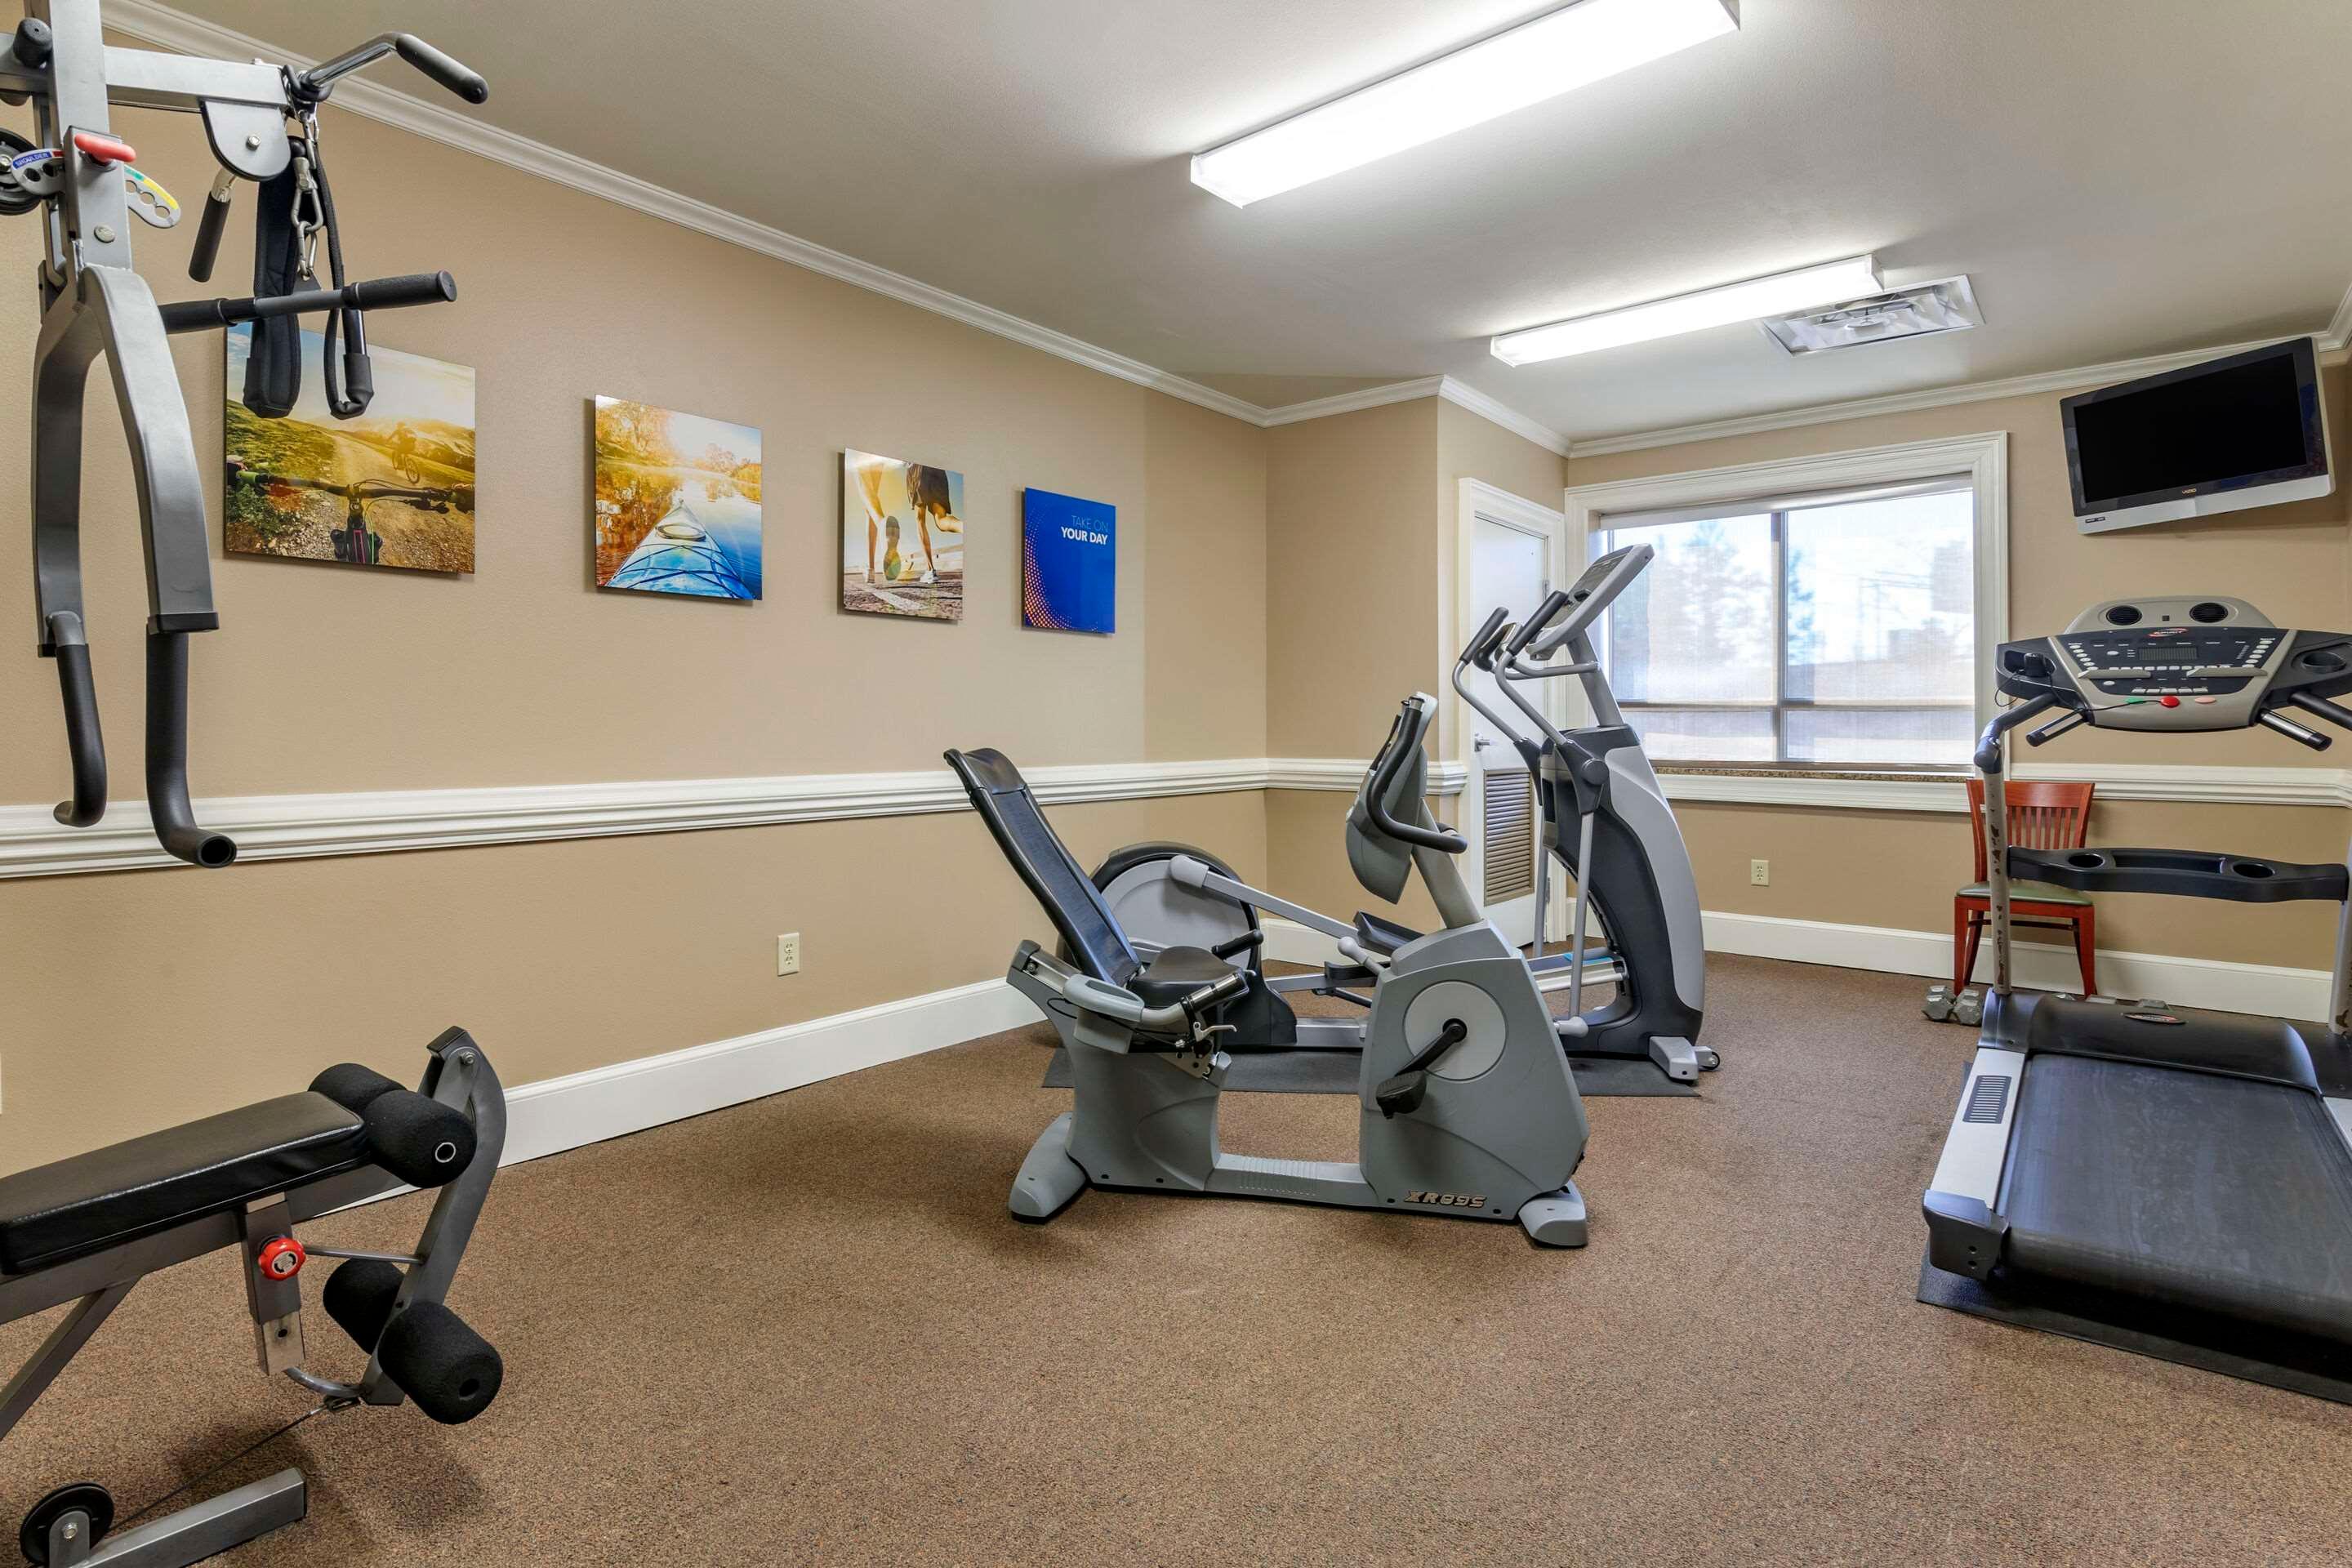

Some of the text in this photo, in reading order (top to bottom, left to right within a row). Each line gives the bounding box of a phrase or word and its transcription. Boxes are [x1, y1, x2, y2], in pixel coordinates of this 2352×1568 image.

[1071, 514, 1109, 532] TAKE ON
[1061, 526, 1109, 546] YOUR DAY
